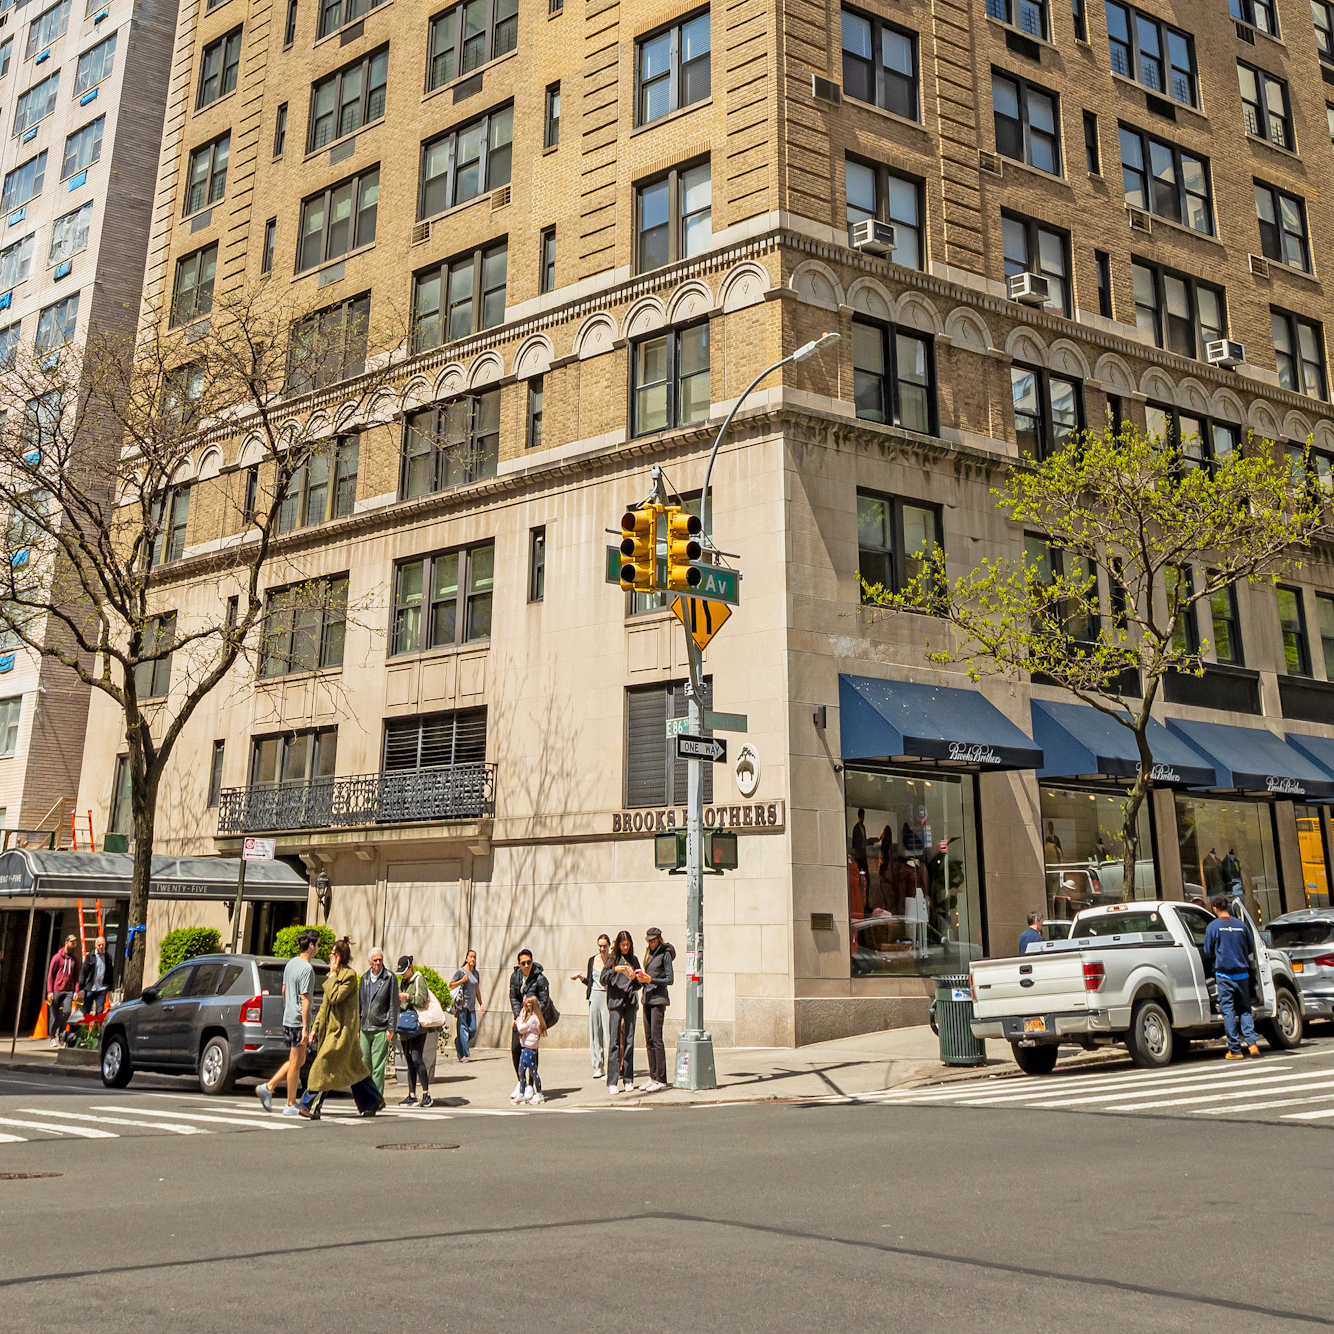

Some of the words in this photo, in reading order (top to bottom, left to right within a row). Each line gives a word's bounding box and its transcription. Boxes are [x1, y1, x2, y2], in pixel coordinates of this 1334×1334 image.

[705, 574, 727, 594] Av
[666, 722, 672, 735] E
[672, 720, 684, 734] 86
[684, 742, 699, 753] ONE
[705, 744, 720, 756] WAY
[948, 742, 974, 761] Brooks
[972, 744, 1002, 764] Brothers
[612, 809, 676, 832] BROOKS
[156, 884, 208, 894] TWENTY-FIVE
